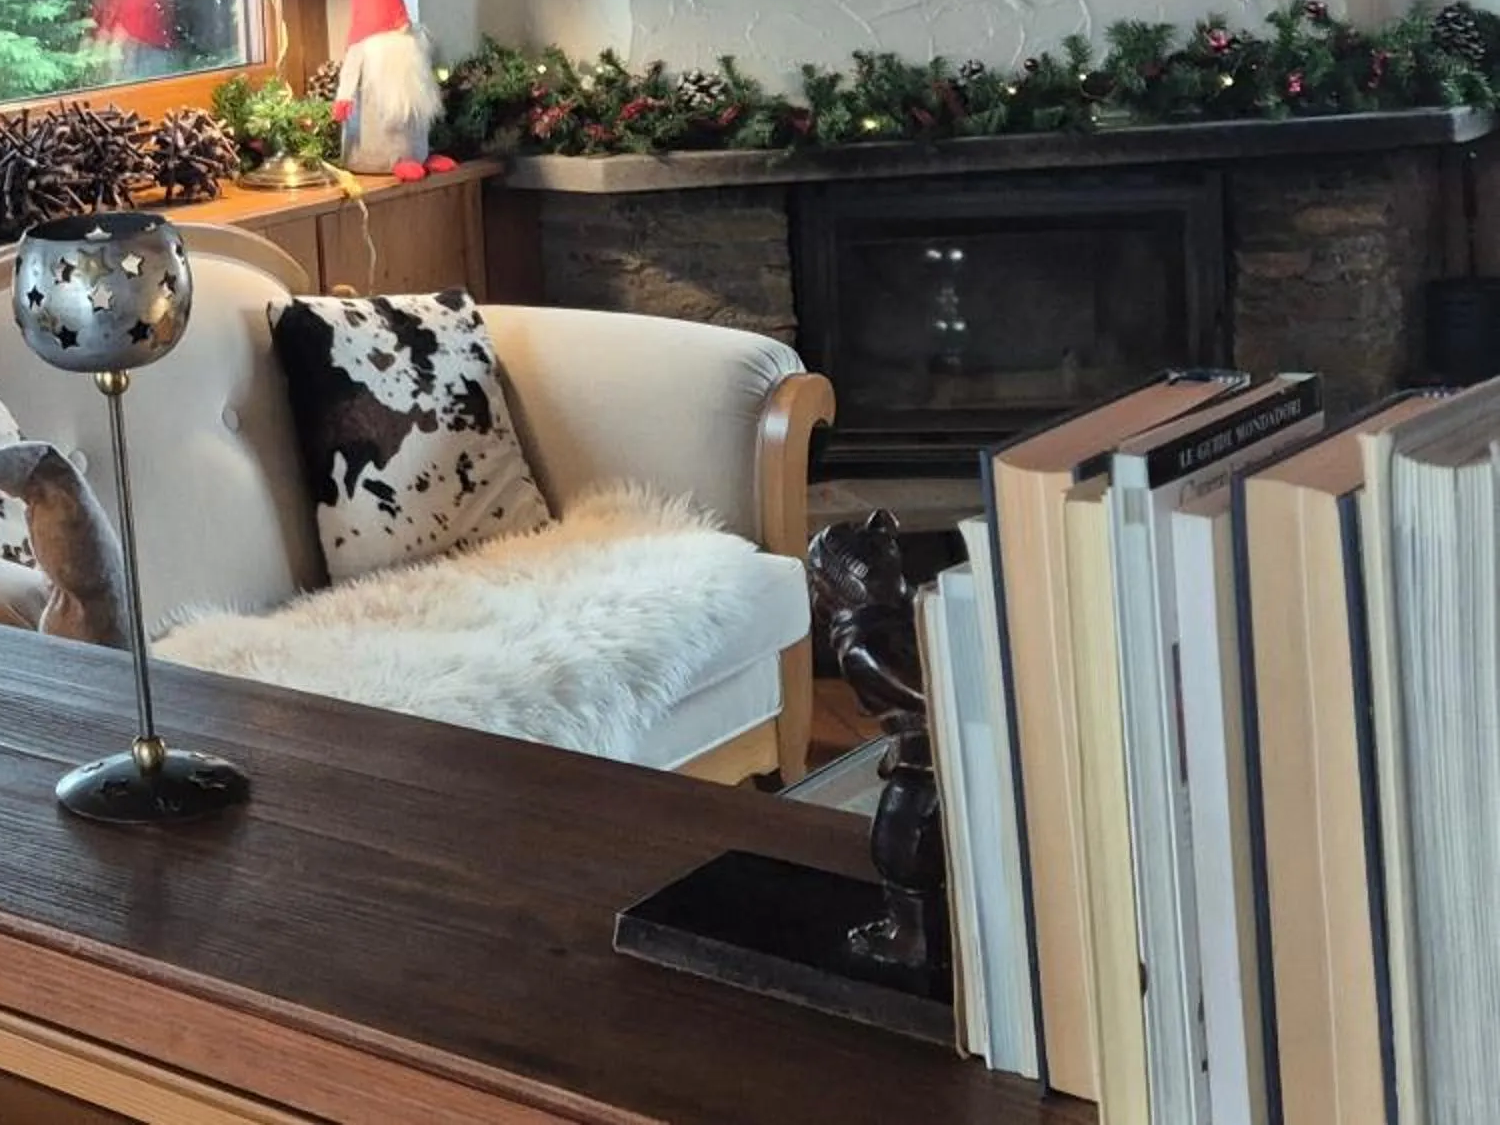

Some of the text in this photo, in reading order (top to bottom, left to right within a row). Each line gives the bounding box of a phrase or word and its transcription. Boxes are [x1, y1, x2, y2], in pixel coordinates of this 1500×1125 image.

[1179, 398, 1301, 469] LE GUIDE MONDADORI
